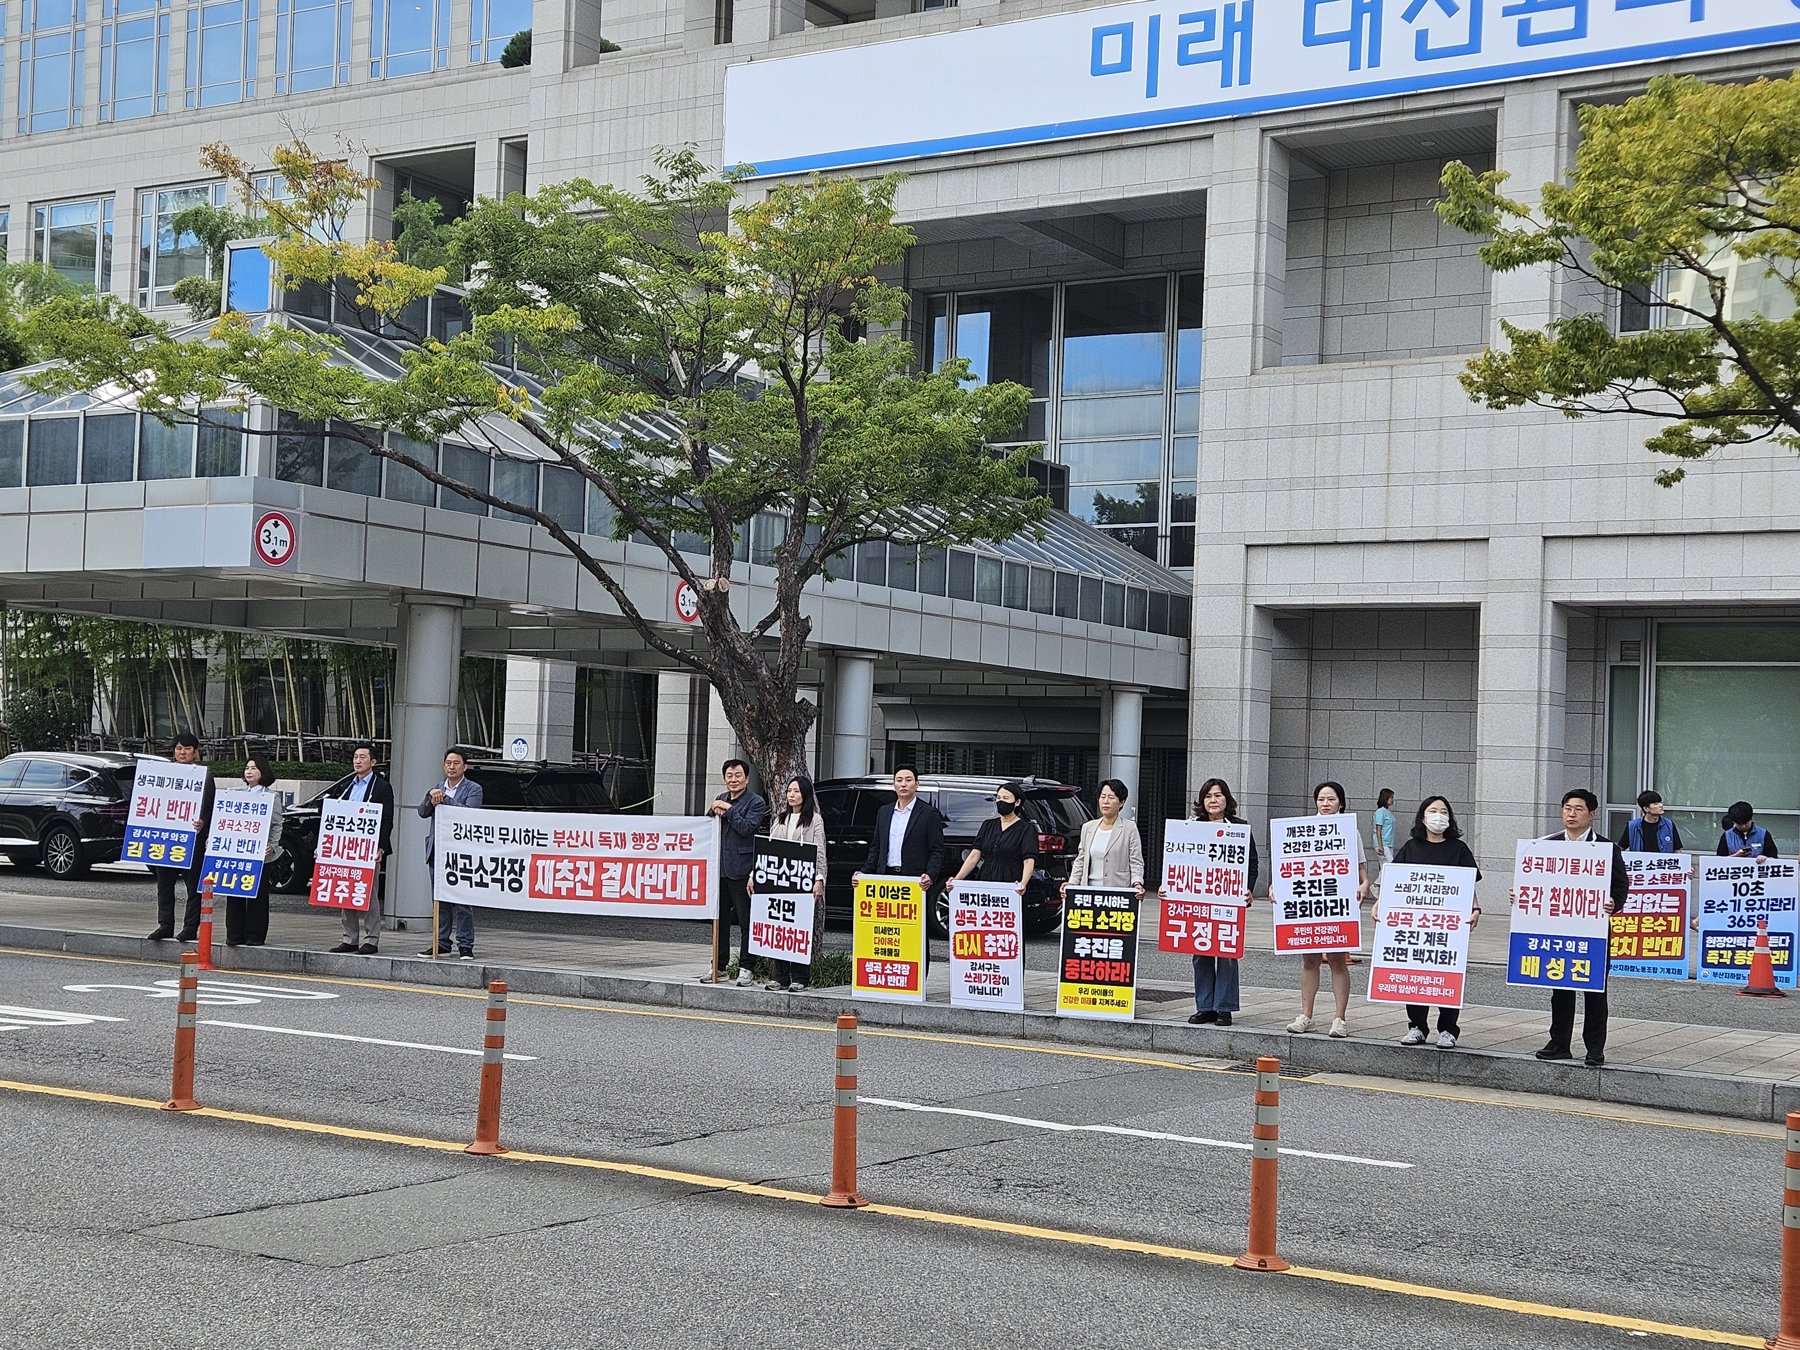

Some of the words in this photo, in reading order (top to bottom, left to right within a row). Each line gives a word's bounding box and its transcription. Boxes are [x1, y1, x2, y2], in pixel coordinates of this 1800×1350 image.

[1091, 0, 1255, 99] 미래
[262, 529, 288, 547] 3.1m
[137, 774, 203, 792] 생곡폐기물시설
[136, 796, 161, 819] 결사
[166, 799, 197, 822] 반대!
[216, 800, 268, 816] 주민생존위협
[217, 818, 261, 833] 생곡소각장
[324, 814, 378, 835] 생곡소각장
[1286, 825, 1315, 839] 깨끗한
[1318, 823, 1340, 836] 공기,
[132, 828, 188, 843] 강서구부의장
[452, 822, 494, 845] 강서주민
[498, 829, 549, 847] 무시하는
[552, 830, 594, 849] 부산시
[598, 831, 627, 849] 독재
[631, 832, 660, 850] 행정
[663, 833, 694, 851] 규탄
[211, 836, 232, 852] 결사
[236, 838, 261, 854] 반대!
[321, 833, 375, 862] 결사반대!
[1165, 841, 1206, 855] 강서구민
[1208, 843, 1246, 864] 주거환경
[1282, 840, 1311, 854] 건강한
[1314, 838, 1346, 851] 강서구!
[214, 859, 253, 871] 강서구의원
[319, 865, 349, 879] 강서구의회
[350, 868, 362, 880] 의장
[755, 854, 815, 891] 생곡소각장
[1279, 861, 1305, 878] 생곡
[1309, 858, 1350, 876] 소각장
[1521, 856, 1605, 876] 생곡폐기물시설
[1705, 866, 1754, 881] 선심공약
[1758, 864, 1795, 879] 발표는
[444, 851, 526, 893] 생곡소각장
[534, 859, 595, 897] 재추진
[600, 862, 699, 900] 결사반대!
[1167, 864, 1202, 894] 부산시는
[1205, 867, 1244, 897] 보장하라!
[1409, 872, 1445, 883] 강서구는
[865, 884, 876, 898] 더
[879, 885, 911, 900] 이상은
[1292, 877, 1338, 898] 추진을
[1394, 883, 1421, 894] 쓰레기
[1423, 884, 1459, 896] 처리장이
[1732, 880, 1765, 897] 10초
[959, 892, 1009, 908] 백지화됐던
[1074, 894, 1092, 907] 주민
[1093, 895, 1129, 909] 무시하는
[1283, 898, 1350, 919] 철회하라!
[1405, 895, 1445, 906] 아닙니다!
[1518, 886, 1543, 915] 즉각
[1549, 886, 1606, 919] 철회하라!
[1703, 899, 1741, 913] 온수기
[1744, 897, 1796, 912] 유지관리
[768, 897, 796, 923] 전면
[860, 900, 873, 917] 안
[876, 901, 917, 920] 됩니다!
[954, 909, 977, 927] 생곡
[980, 911, 1016, 928] 소각장
[1167, 903, 1210, 919] 강서구의회
[1067, 909, 1093, 929] 생곡
[1095, 910, 1136, 932] 소각장
[1386, 911, 1414, 927] 생곡
[1417, 913, 1461, 930] 소각장
[1641, 916, 1680, 933] 온수기
[752, 921, 810, 955] 백지화하라
[1293, 926, 1312, 935] 주민의
[1394, 930, 1419, 945] 추진
[1423, 931, 1448, 947] 계획
[955, 933, 982, 956] 다시
[984, 933, 1016, 957] 추진?
[1074, 936, 1124, 959] 추진을
[1527, 938, 1588, 953] 강서구의원
[1642, 936, 1683, 957] 반대
[1705, 935, 1747, 948] 현장인력
[1382, 946, 1408, 962] 전면
[1412, 948, 1457, 966] 백지화!
[1706, 950, 1732, 965] 즉각
[865, 961, 882, 974] 생곡
[884, 962, 910, 976] 소각장
[970, 961, 1000, 973] 강서구는
[1065, 958, 1131, 983] 중단하라!
[868, 973, 885, 986] 결사
[887, 975, 907, 988] 반대!
[964, 972, 1009, 986] 쓰레기장이
[1389, 973, 1408, 984] 주민이
[968, 985, 1003, 997] 아닙니다!
[1078, 987, 1089, 995] 우리
